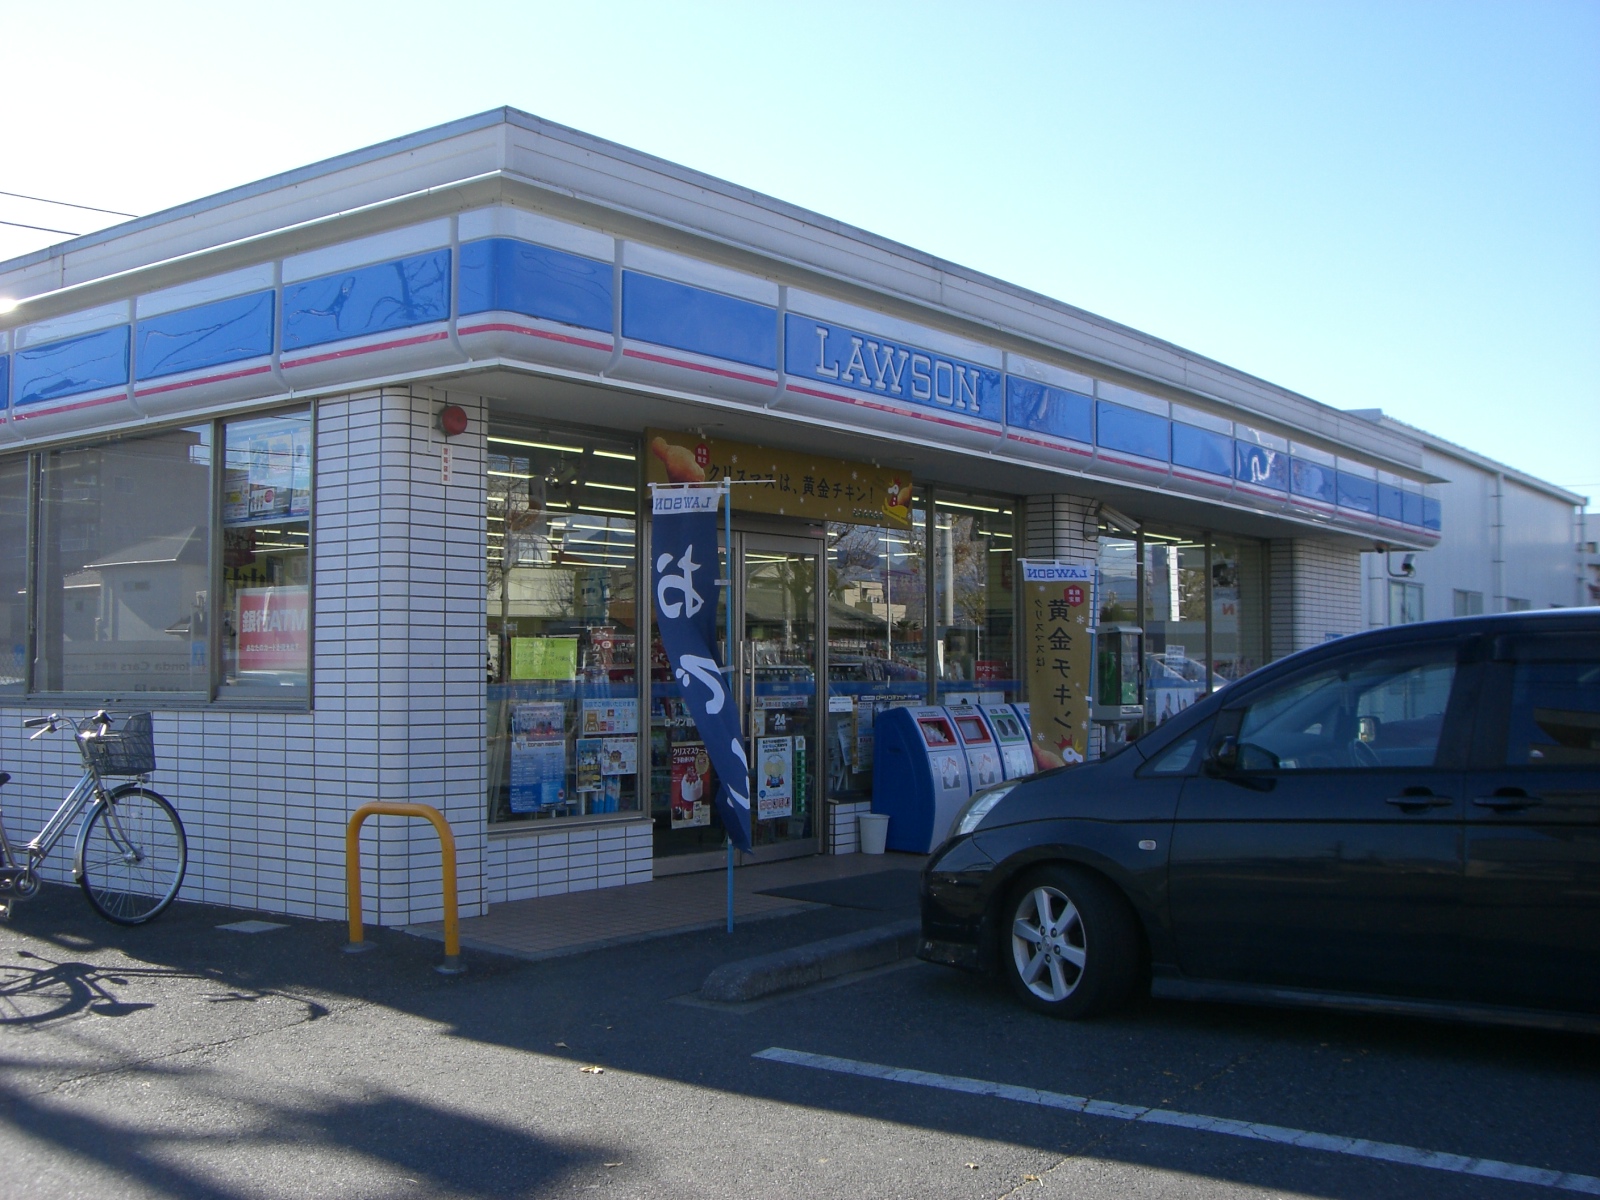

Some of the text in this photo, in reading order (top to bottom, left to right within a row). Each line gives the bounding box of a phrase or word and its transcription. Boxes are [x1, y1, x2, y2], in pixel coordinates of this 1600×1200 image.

[816, 326, 980, 413] LAWSON
[242, 609, 307, 633] 銀行ATM
[774, 713, 786, 726] 24
